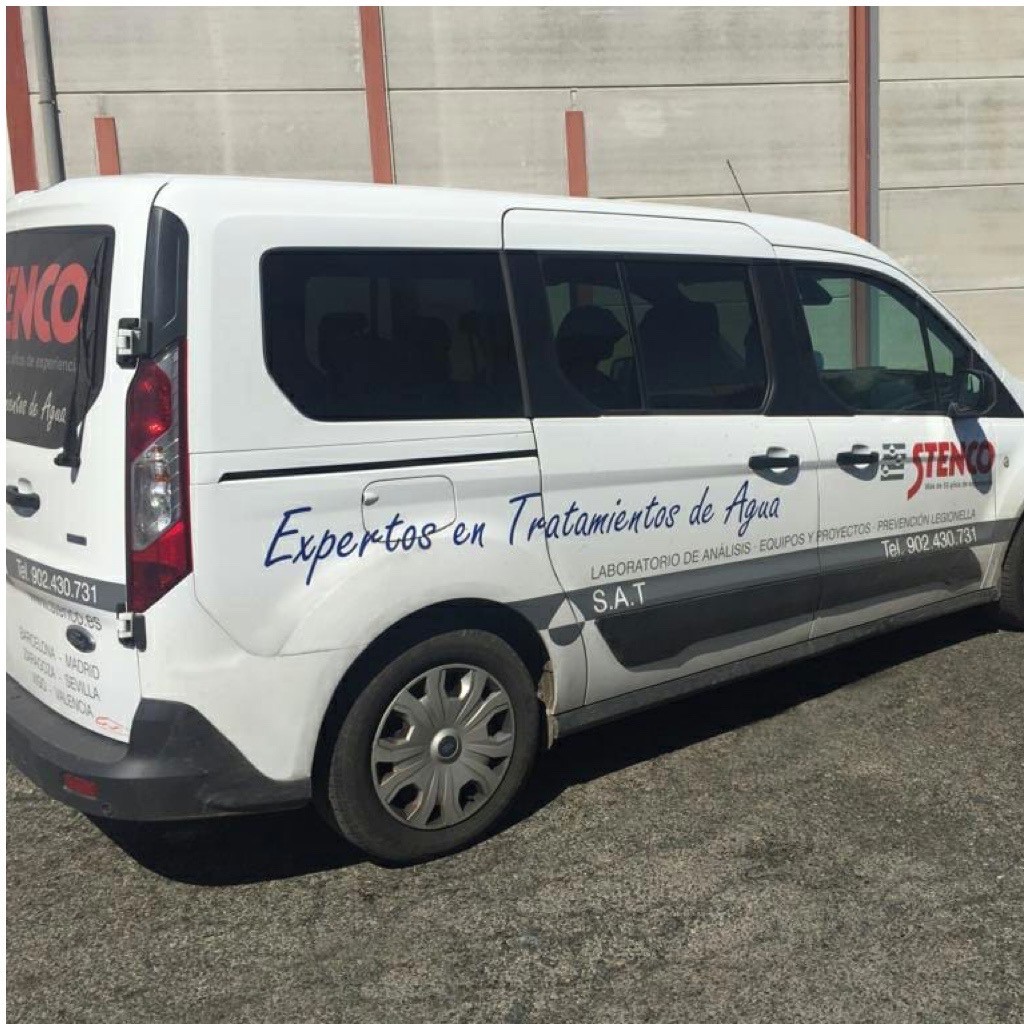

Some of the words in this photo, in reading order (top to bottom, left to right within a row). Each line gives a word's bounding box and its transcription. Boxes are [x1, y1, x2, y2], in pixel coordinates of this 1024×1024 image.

[907, 441, 995, 501] STENCO
[264, 506, 434, 586] Expertos
[452, 522, 487, 548] en
[508, 492, 681, 546] Tratamientos
[689, 485, 714, 525] de
[723, 480, 781, 537] Agua
[590, 553, 681, 580] LABORATORIO
[683, 550, 699, 565] DE
[702, 541, 752, 561] ANÁLISIS
[759, 533, 806, 552] EQUIPOS
[807, 532, 814, 543] Y
[816, 521, 871, 542] PROYECTOS
[930, 507, 976, 525] LEGIONELLA
[905, 526, 977, 555] 902.430.731
[31, 565, 97, 603] 902.430.731
[592, 581, 646, 614] S.A.T
[65, 653, 100, 681] MADRID
[64, 674, 102, 702] SEVILLA
